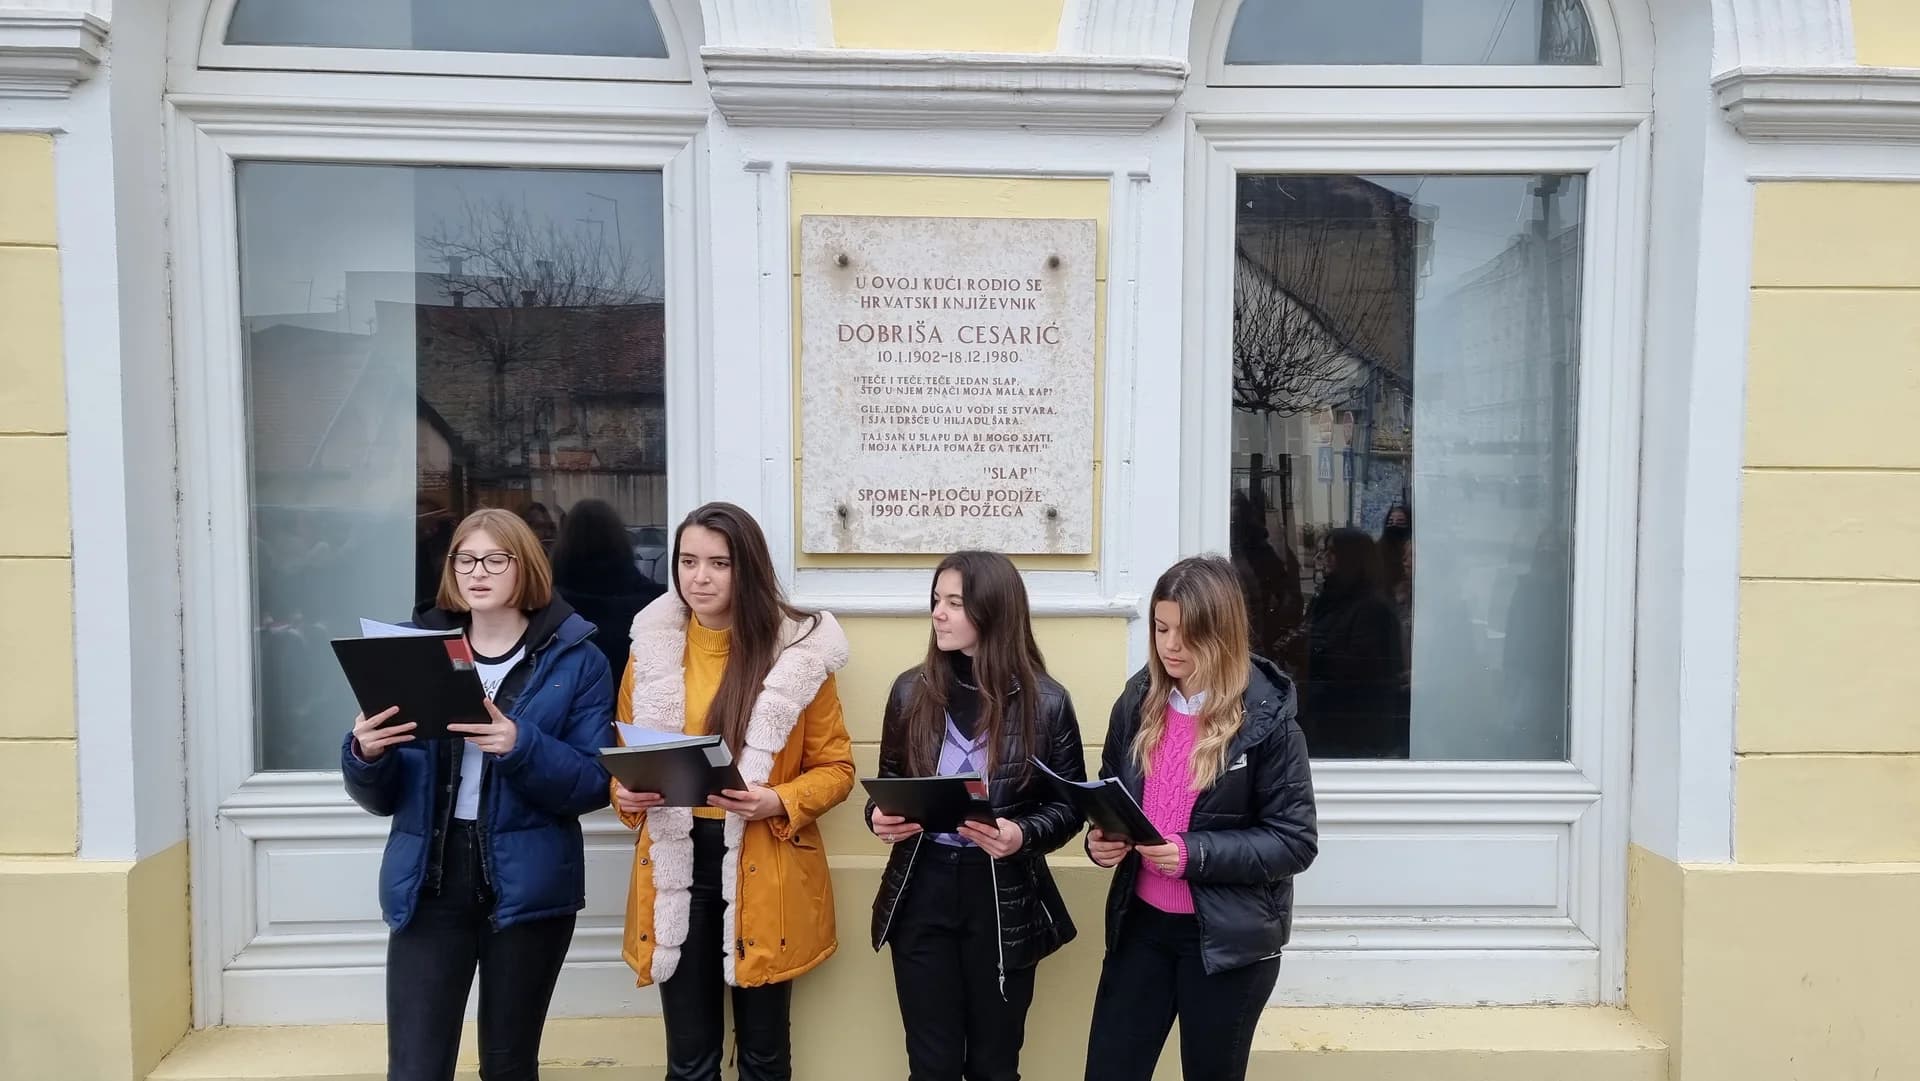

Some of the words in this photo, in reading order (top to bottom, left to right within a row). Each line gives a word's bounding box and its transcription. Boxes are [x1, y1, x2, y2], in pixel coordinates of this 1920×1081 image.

[856, 277, 865, 289] U
[872, 276, 917, 290] OVOJ
[924, 275, 960, 290] KUĆI
[967, 278, 1020, 291] RODIO
[1026, 278, 1042, 291] SE
[861, 296, 937, 309] HRVATSKI
[943, 294, 1036, 310] KNJIŽEVNIK
[838, 320, 943, 343] DOBRIŠA
[958, 321, 1060, 344] CESARIĆ
[926, 375, 951, 385] TEČE
[955, 377, 988, 385] JEDAN
[860, 385, 881, 394] ŠTO
[885, 386, 892, 394] U
[896, 386, 923, 395] NJEM
[926, 385, 959, 395] ZNAČI
[963, 387, 992, 396] MOJA
[996, 387, 1024, 396] MALA
[884, 405, 917, 414] JEDNA
[922, 405, 951, 414] DUGA
[955, 406, 962, 414] U
[967, 406, 993, 414] VODI
[997, 406, 1008, 414] SE
[868, 416, 886, 424] SJA
[897, 414, 929, 424] DRŠĆE
[933, 416, 939, 424] U
[944, 416, 991, 425] HILJADU
[861, 433, 881, 441] TAJ
[885, 433, 905, 441] SAN
[908, 433, 915, 441] U
[920, 433, 950, 441] SLAPU
[954, 433, 968, 442] DA
[973, 433, 982, 441] BI
[986, 433, 1019, 442] MOGO
[868, 443, 897, 451] MOJA
[901, 443, 940, 452] KAPLJA
[944, 442, 985, 452] POMAŽE
[989, 444, 1004, 452] GA
[983, 466, 1037, 480] "SLAP"
[858, 486, 981, 501] SPOMEN-PLOČU
[986, 487, 1042, 502] PODIŽE
[908, 504, 955, 517] GRAD
[961, 502, 1024, 517] POŽEGA
